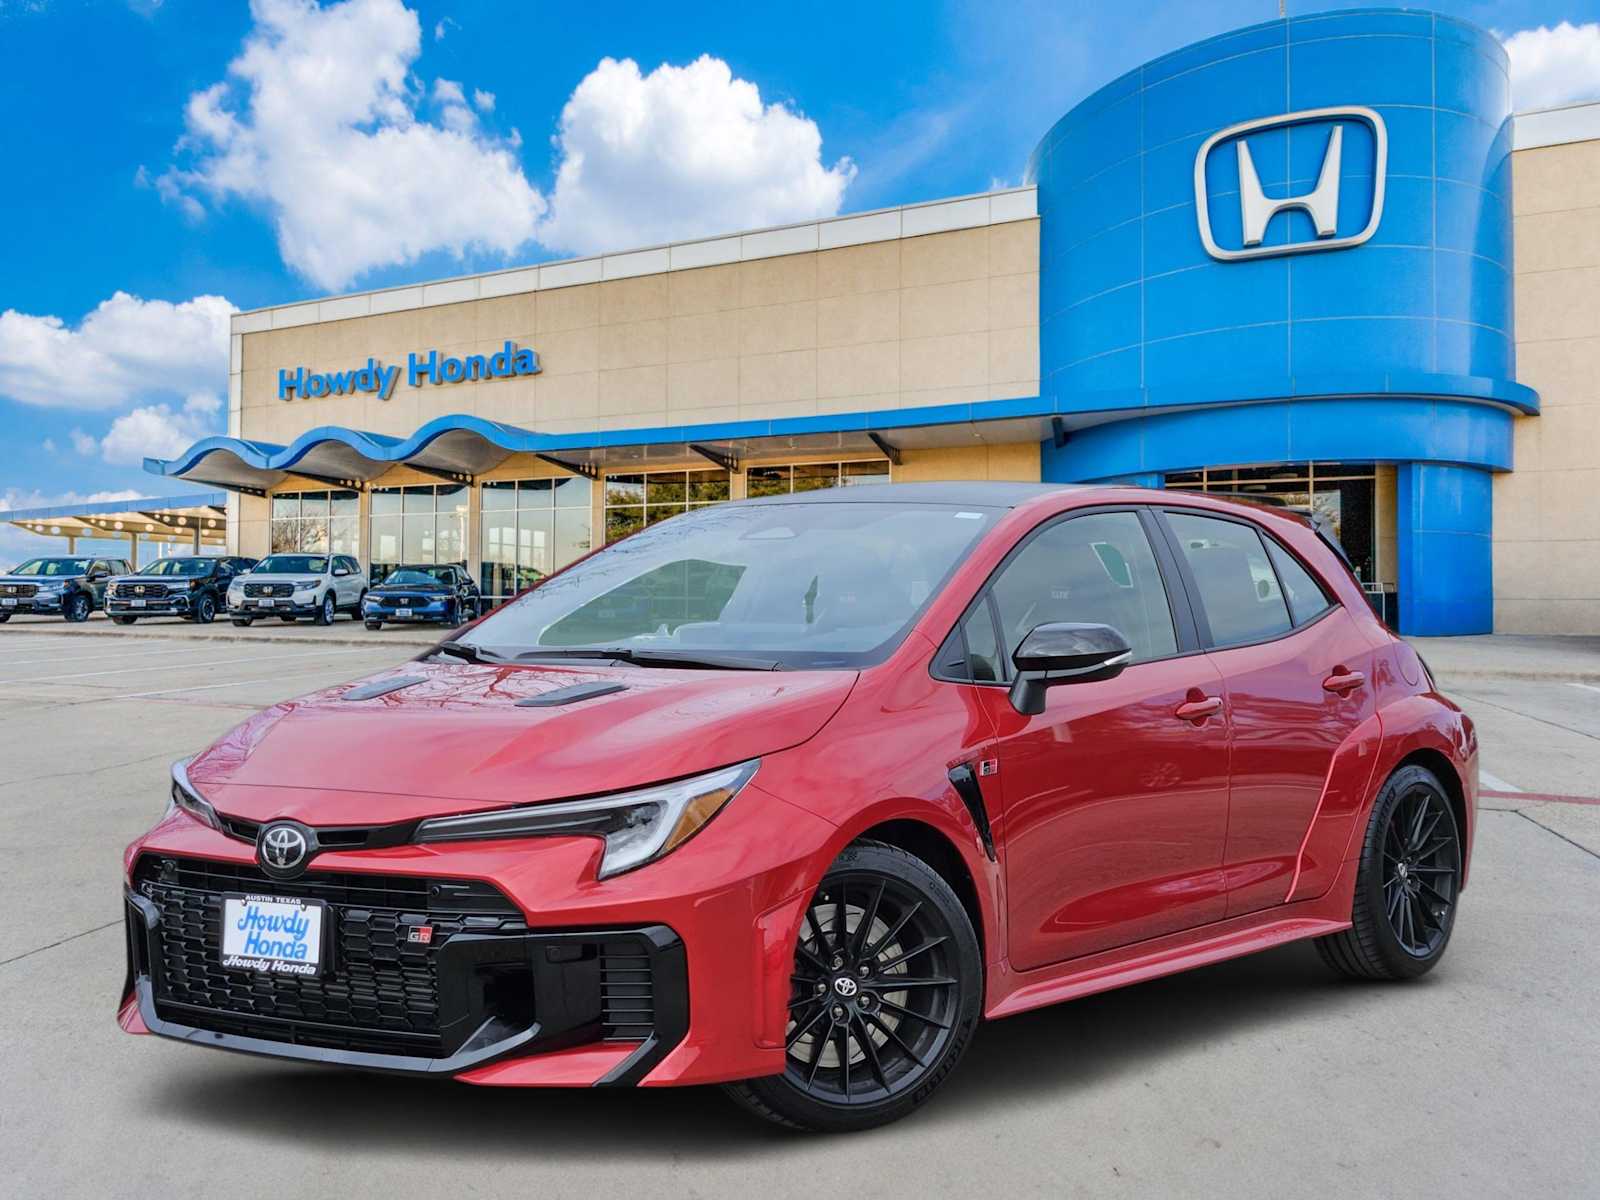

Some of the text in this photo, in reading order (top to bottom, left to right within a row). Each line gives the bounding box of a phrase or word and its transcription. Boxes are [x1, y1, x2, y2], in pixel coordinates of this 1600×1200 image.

[279, 340, 542, 401] Howdy Honda
[245, 895, 302, 905] AUSTIN TEXAS
[238, 906, 309, 940] Howdy
[243, 931, 308, 959] Honda
[222, 955, 317, 975] Howdy Honda
